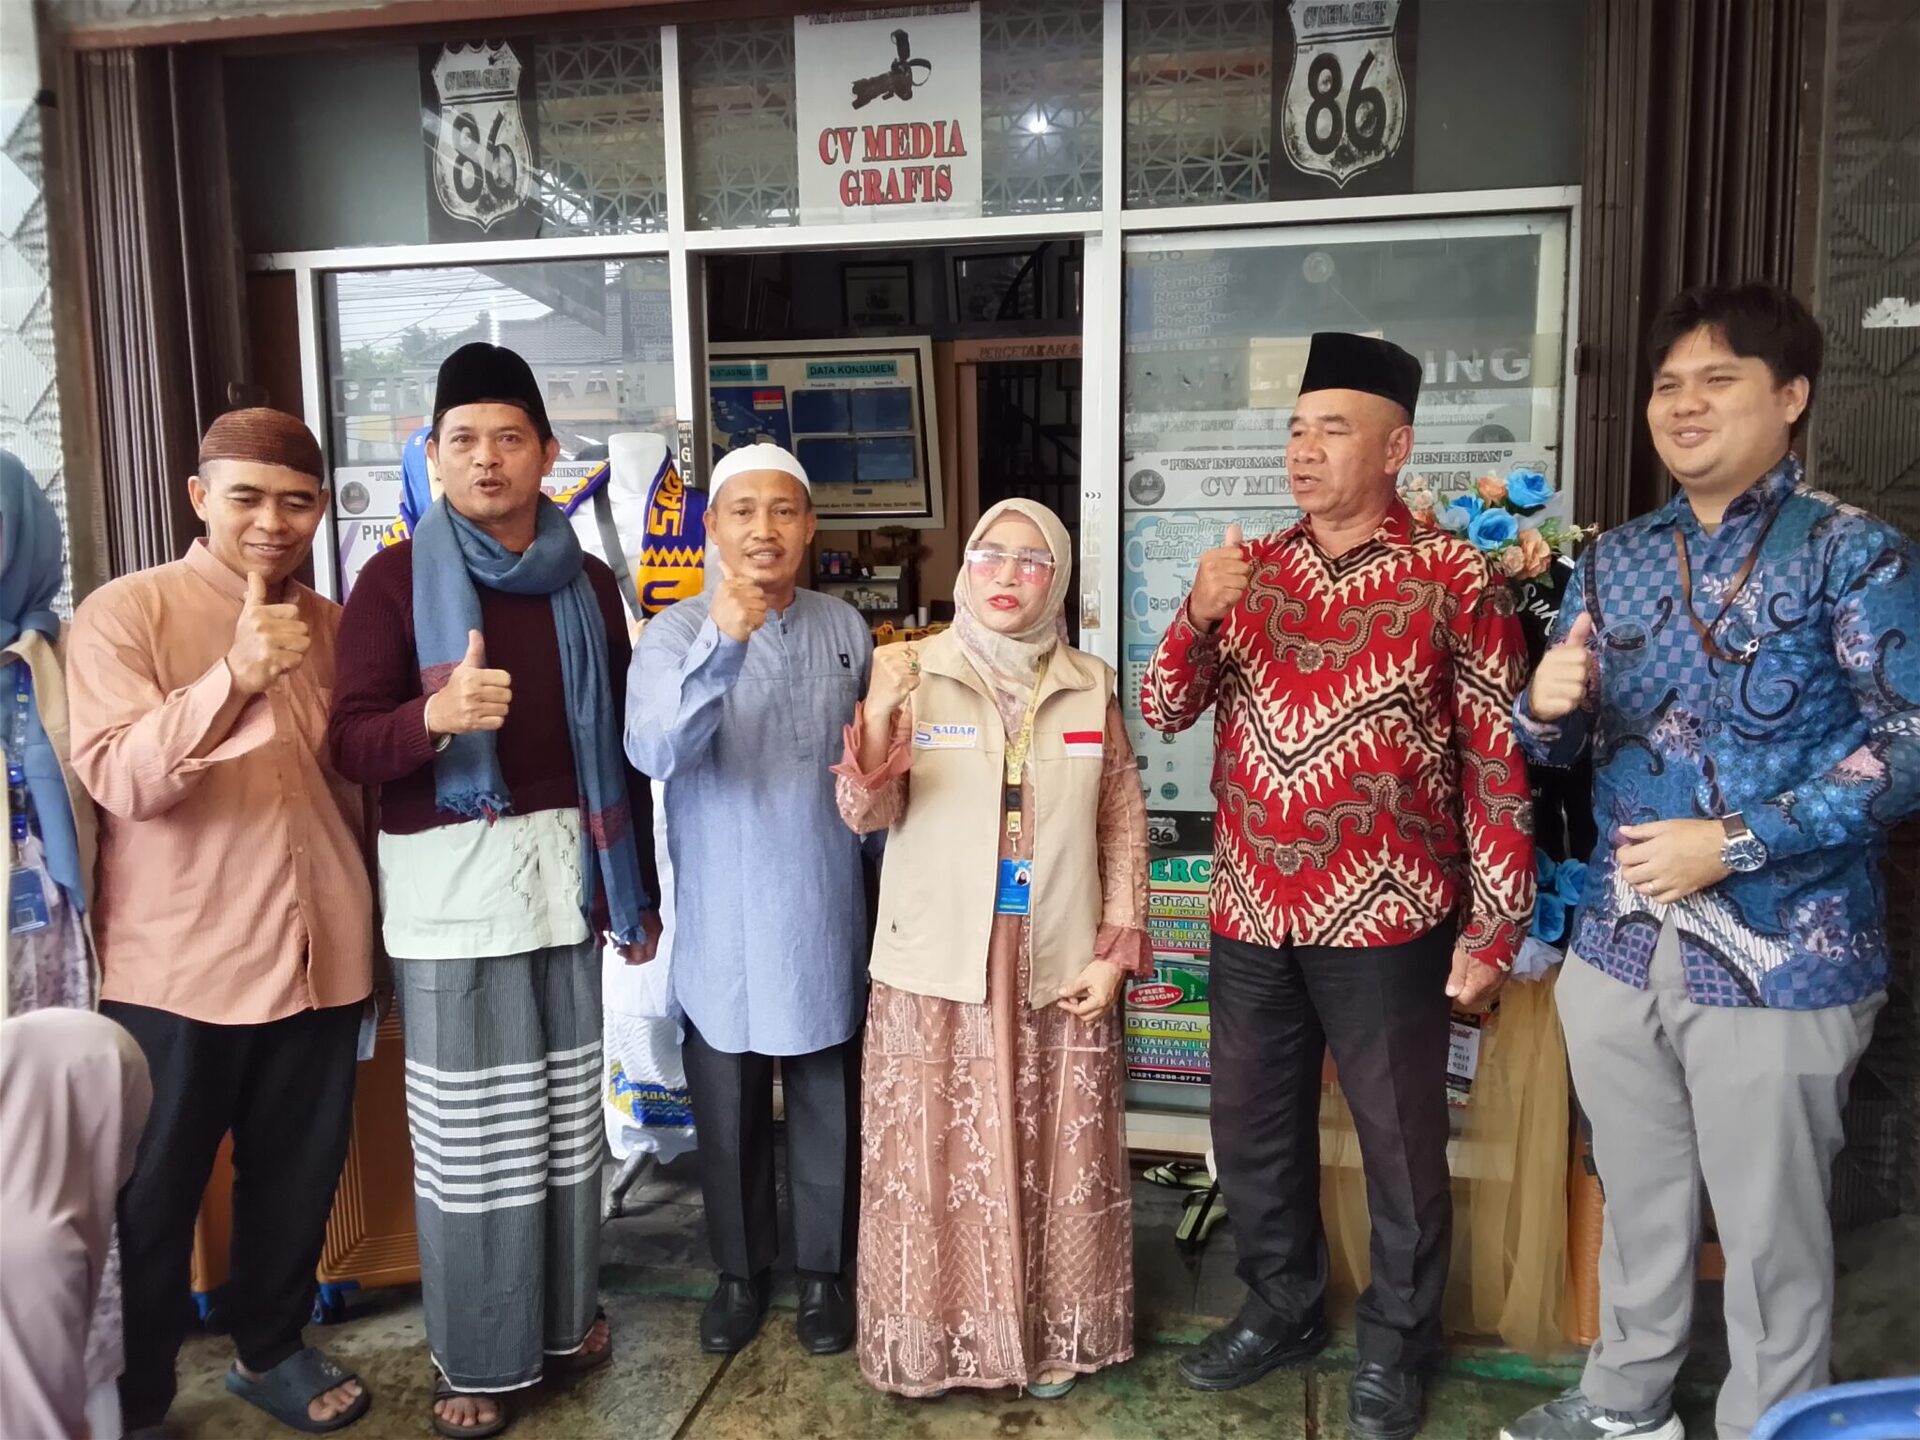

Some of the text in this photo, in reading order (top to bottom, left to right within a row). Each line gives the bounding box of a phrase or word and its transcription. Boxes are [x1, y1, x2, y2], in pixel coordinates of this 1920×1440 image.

[1305, 48, 1387, 156] 86
[818, 119, 967, 166] CV MEDIA
[451, 110, 518, 203] 86
[839, 165, 953, 207] GRAFIS
[809, 363, 894, 376] DATA KONSUMEN
[1423, 348, 1531, 384] ING
[1169, 450, 1503, 471] PUSAT INFORMASI PENERBITAN
[375, 471, 402, 481] PUSA
[1200, 475, 1240, 497] CV
[1401, 470, 1473, 492] AFIS
[932, 725, 976, 736] SADAR
[1148, 827, 1173, 842] 86
[1151, 858, 1210, 883] ERC
[1150, 895, 1205, 909] GITAL
[1151, 919, 1180, 929] NDUK
[1153, 930, 1175, 939] KER
[1138, 987, 1166, 996] FREE
[1128, 1017, 1202, 1033] DIGITAL
[1127, 1037, 1187, 1048] UNDANGAN
[1127, 1046, 1181, 1056] MAJALAH
[1193, 1050, 1209, 1058] KA
[1127, 1055, 1192, 1067] SERTIFIKAT
